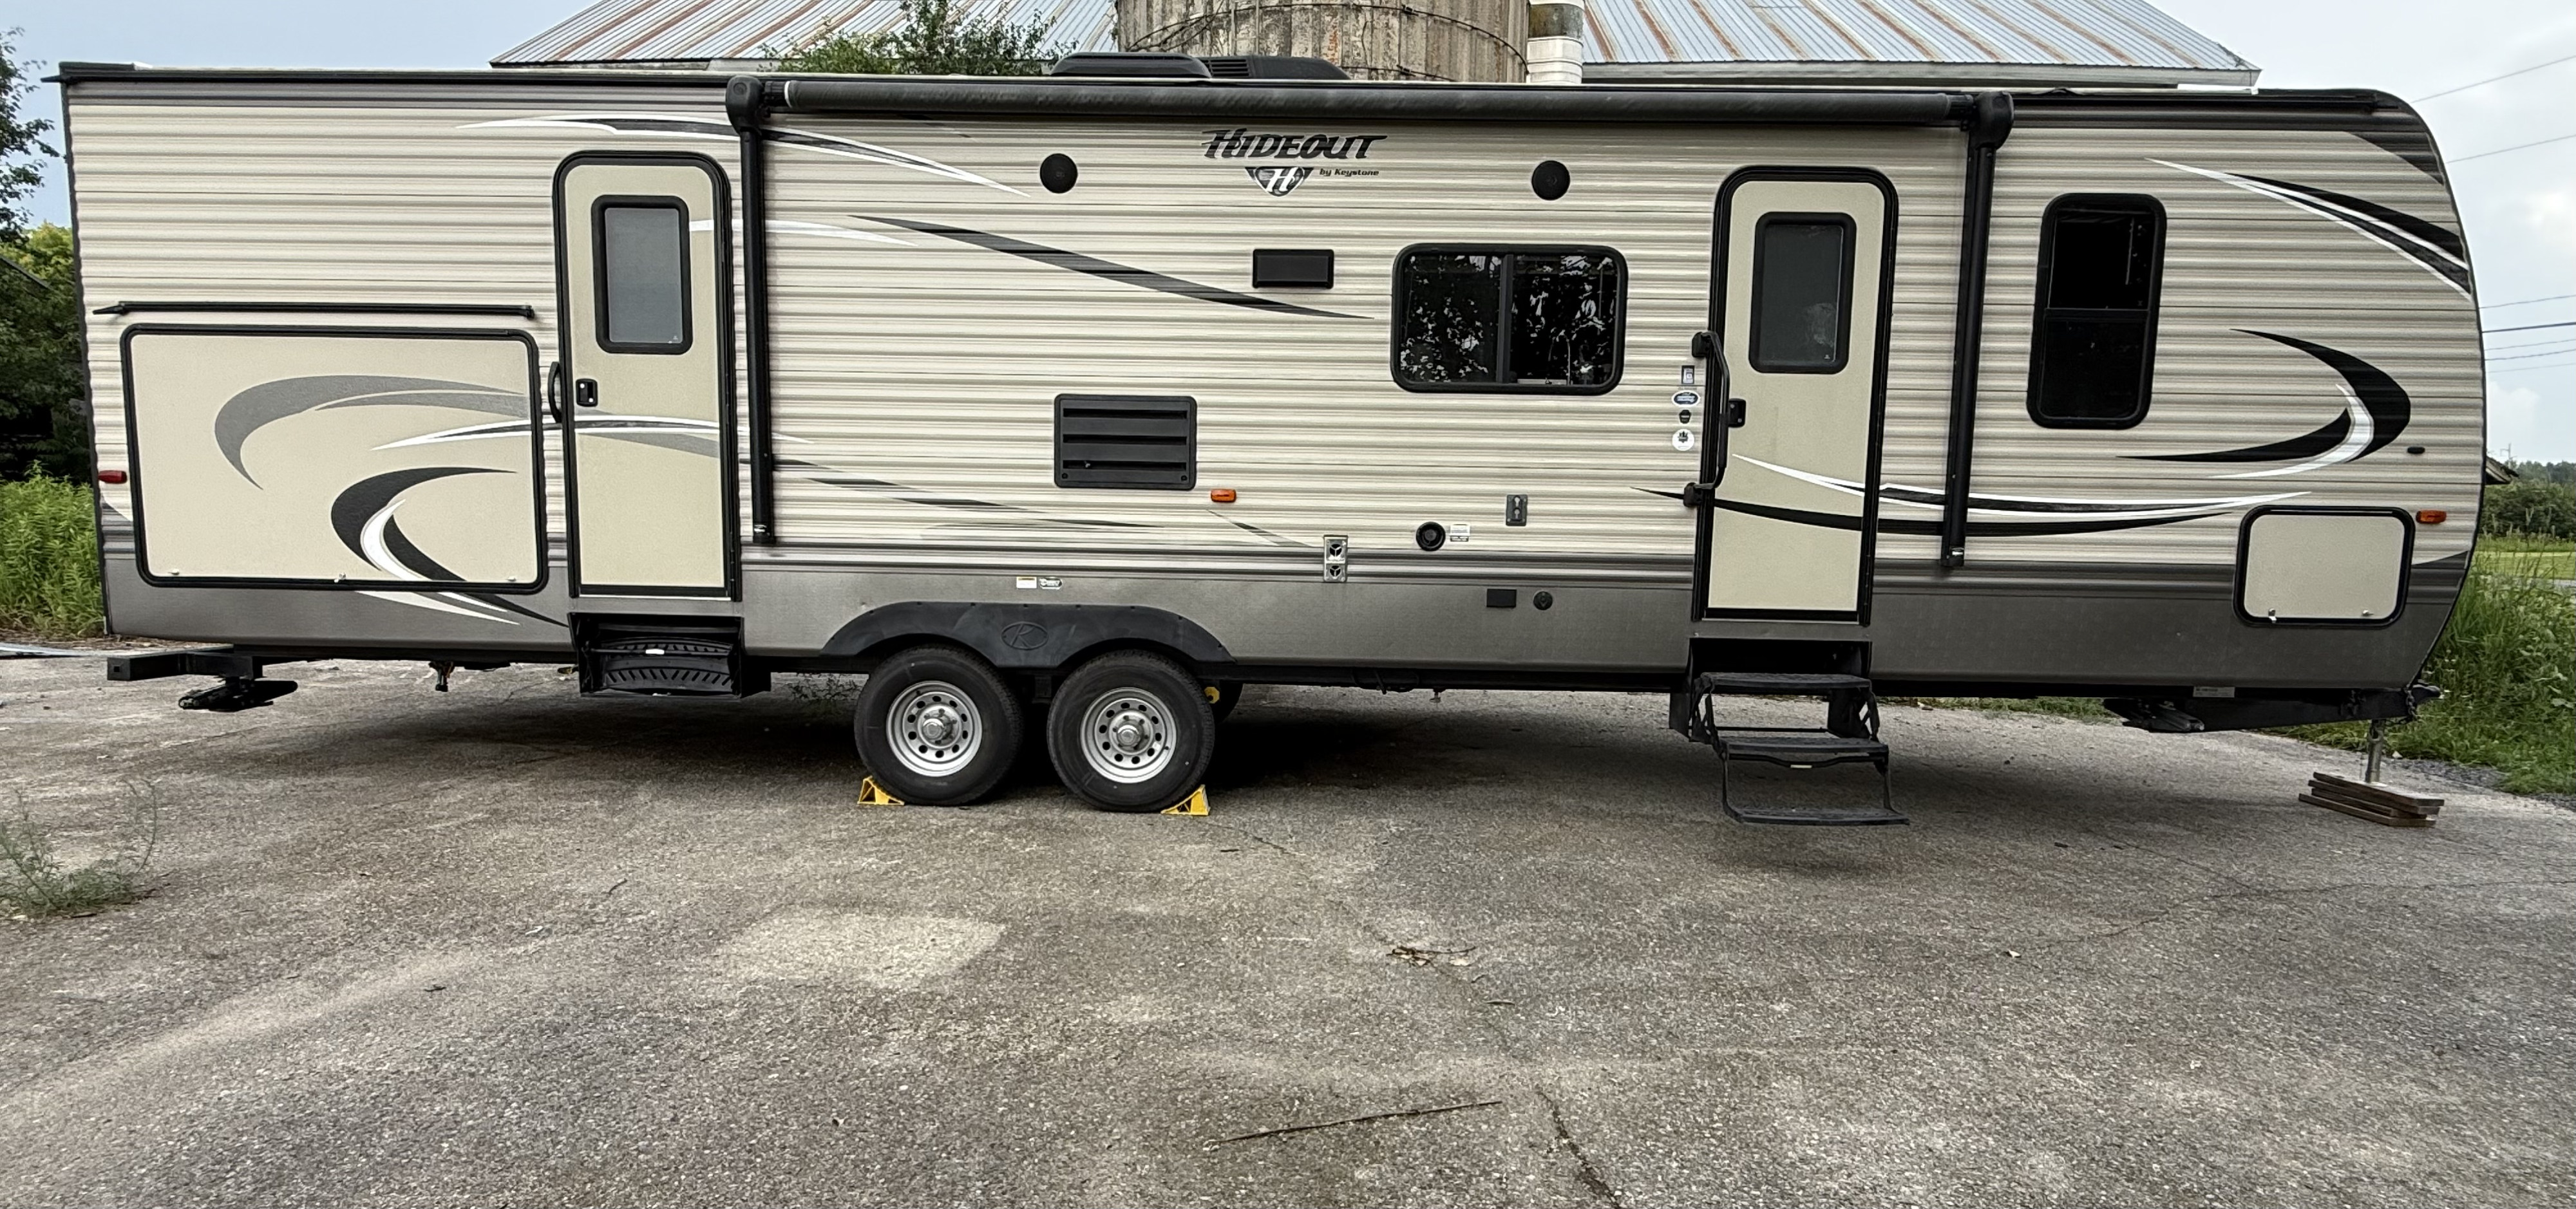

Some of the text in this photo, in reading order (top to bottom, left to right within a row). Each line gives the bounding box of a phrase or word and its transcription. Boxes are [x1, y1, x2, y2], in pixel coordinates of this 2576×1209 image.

[1202, 127, 1388, 159] HIDEOUT
[1267, 167, 1299, 192] H
[1334, 168, 1379, 177] Keystone
